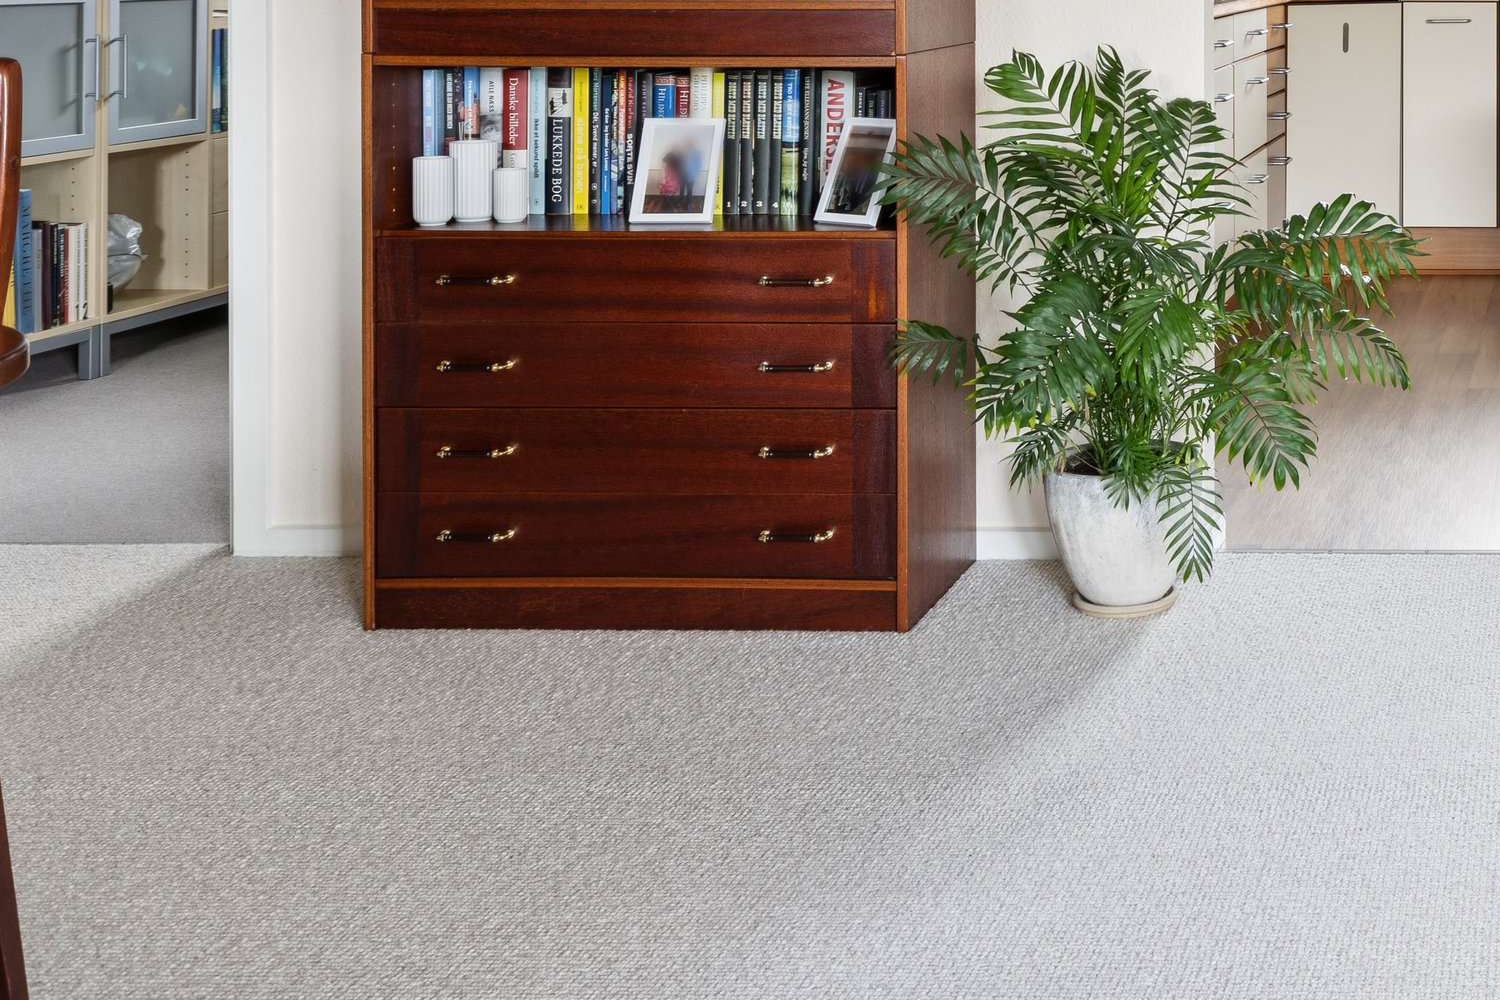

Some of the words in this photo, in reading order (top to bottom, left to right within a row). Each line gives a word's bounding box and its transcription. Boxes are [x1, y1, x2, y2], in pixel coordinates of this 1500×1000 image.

[509, 78, 519, 110] Danske
[627, 76, 635, 98] David
[552, 90, 564, 114] DEN
[728, 100, 737, 113] MED
[742, 100, 752, 113] MED
[757, 100, 767, 113] MED
[773, 100, 782, 113] MED
[627, 99, 635, 129] Nielsen
[509, 112, 519, 146] billeder
[576, 117, 585, 144] alene
[592, 124, 600, 141] Svend
[826, 78, 845, 176] ANDERS
[552, 119, 563, 174] LUKKEDE
[575, 147, 588, 159] på
[591, 142, 599, 160] mener,
[626, 133, 634, 162] SORTE
[509, 153, 518, 168] Geo
[576, 163, 586, 193] banen
[551, 178, 563, 202] BOG
[741, 200, 748, 208] 2
[756, 200, 763, 208] 3
